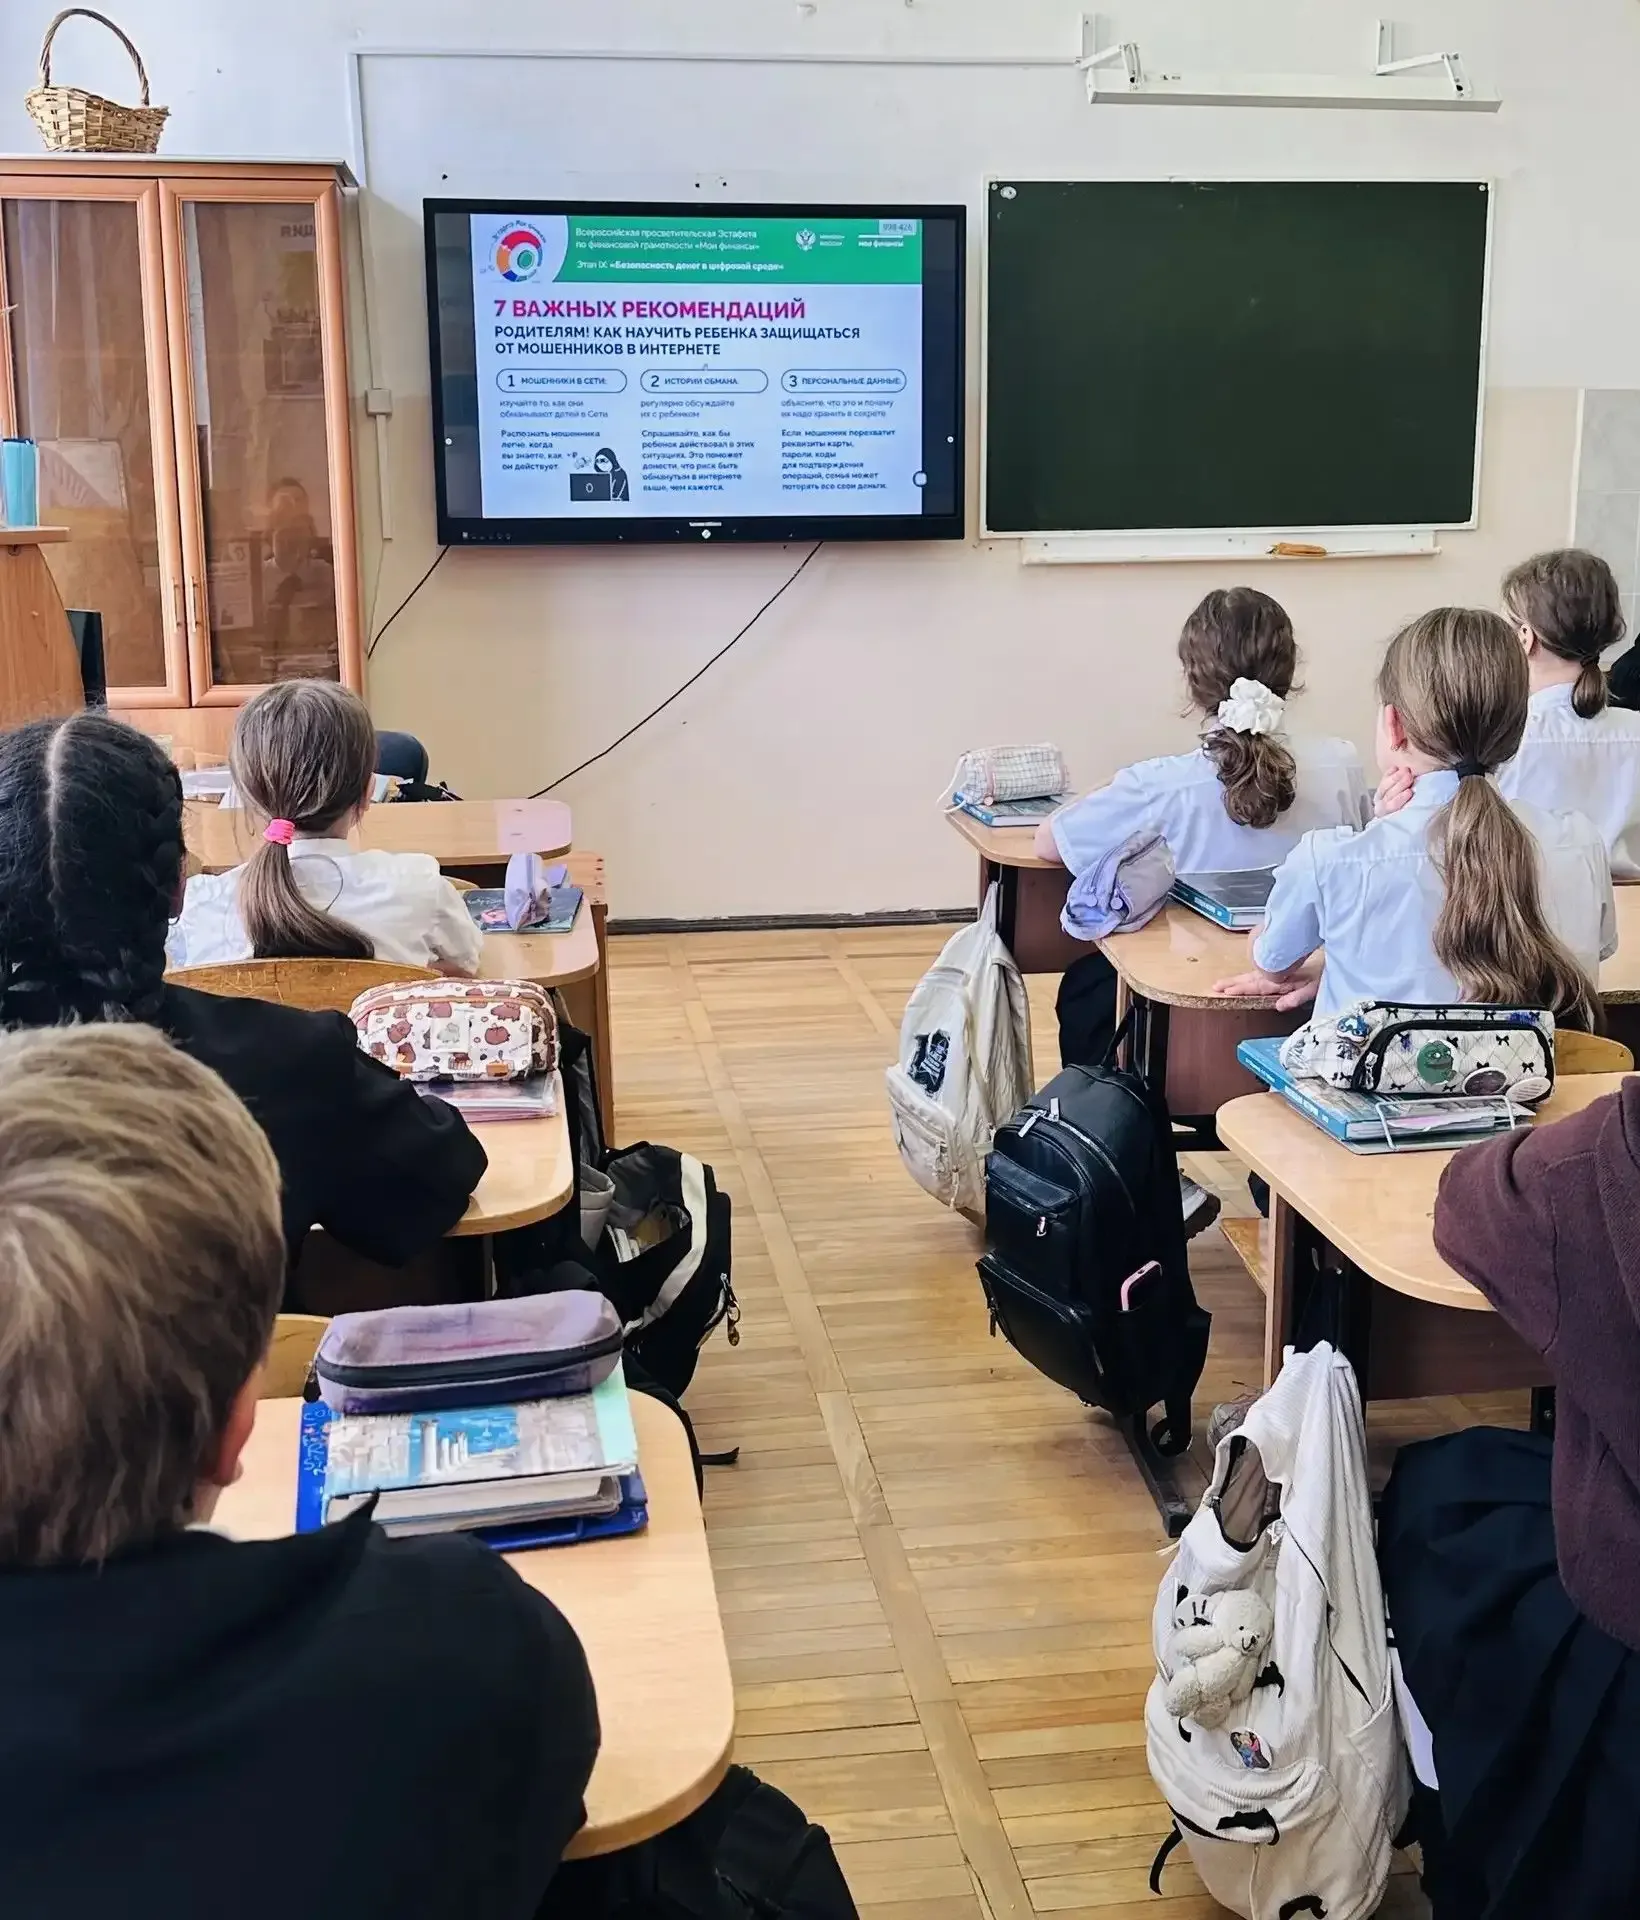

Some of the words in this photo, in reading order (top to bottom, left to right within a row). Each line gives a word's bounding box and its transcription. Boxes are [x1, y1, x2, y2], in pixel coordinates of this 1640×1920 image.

[575, 227, 640, 238] Всероссийская
[641, 229, 716, 239] просветительская
[718, 229, 757, 239] Эстафета
[588, 240, 639, 250] финансовой
[640, 242, 693, 250] грамотности
[576, 260, 597, 269] Этап
[676, 263, 700, 271] денег
[708, 261, 751, 272] цифровой
[494, 300, 507, 318] 7
[513, 300, 617, 318] ВАЖНЫХ
[622, 298, 805, 321] РЕКОМЕНДАЦИЙ
[495, 326, 590, 340] РОДИТЕЛЯМ!
[594, 327, 622, 339] КАК
[626, 327, 691, 339] НАУЧИТЬ
[695, 328, 757, 339] РЕБЕНКА
[760, 327, 860, 341] ЗАЩИЩАТЬСЯ
[495, 343, 513, 355] ОТ
[517, 343, 623, 355] МОШЕННИКОВ
[627, 344, 636, 355] В
[640, 344, 721, 355] ИНТЕРНЕТЕ
[507, 374, 515, 387] 1
[521, 377, 576, 385] МОШЕННИКИ
[577, 377, 582, 385] В
[650, 375, 660, 388] 2
[789, 375, 798, 387] 3
[801, 377, 865, 385] ПЕРСОНАЛЬНЫЕ
[500, 400, 538, 408] изучайте
[640, 401, 684, 409] регулярно
[685, 400, 735, 409] обсуждайте
[865, 401, 895, 409] почему
[554, 411, 580, 419] детей
[587, 410, 608, 418] Сети
[814, 411, 846, 419] хранить
[853, 411, 886, 419] секрете
[501, 429, 550, 438] Распознать
[782, 429, 801, 437] Если
[848, 430, 896, 438] перехватит
[679, 441, 728, 449] действовал
[782, 441, 826, 449] реквизиты
[688, 451, 704, 459] Это
[696, 463, 716, 471] риск
[798, 462, 864, 470] подтверждения
[642, 473, 691, 481] обманутым
[782, 483, 819, 491] потерять
